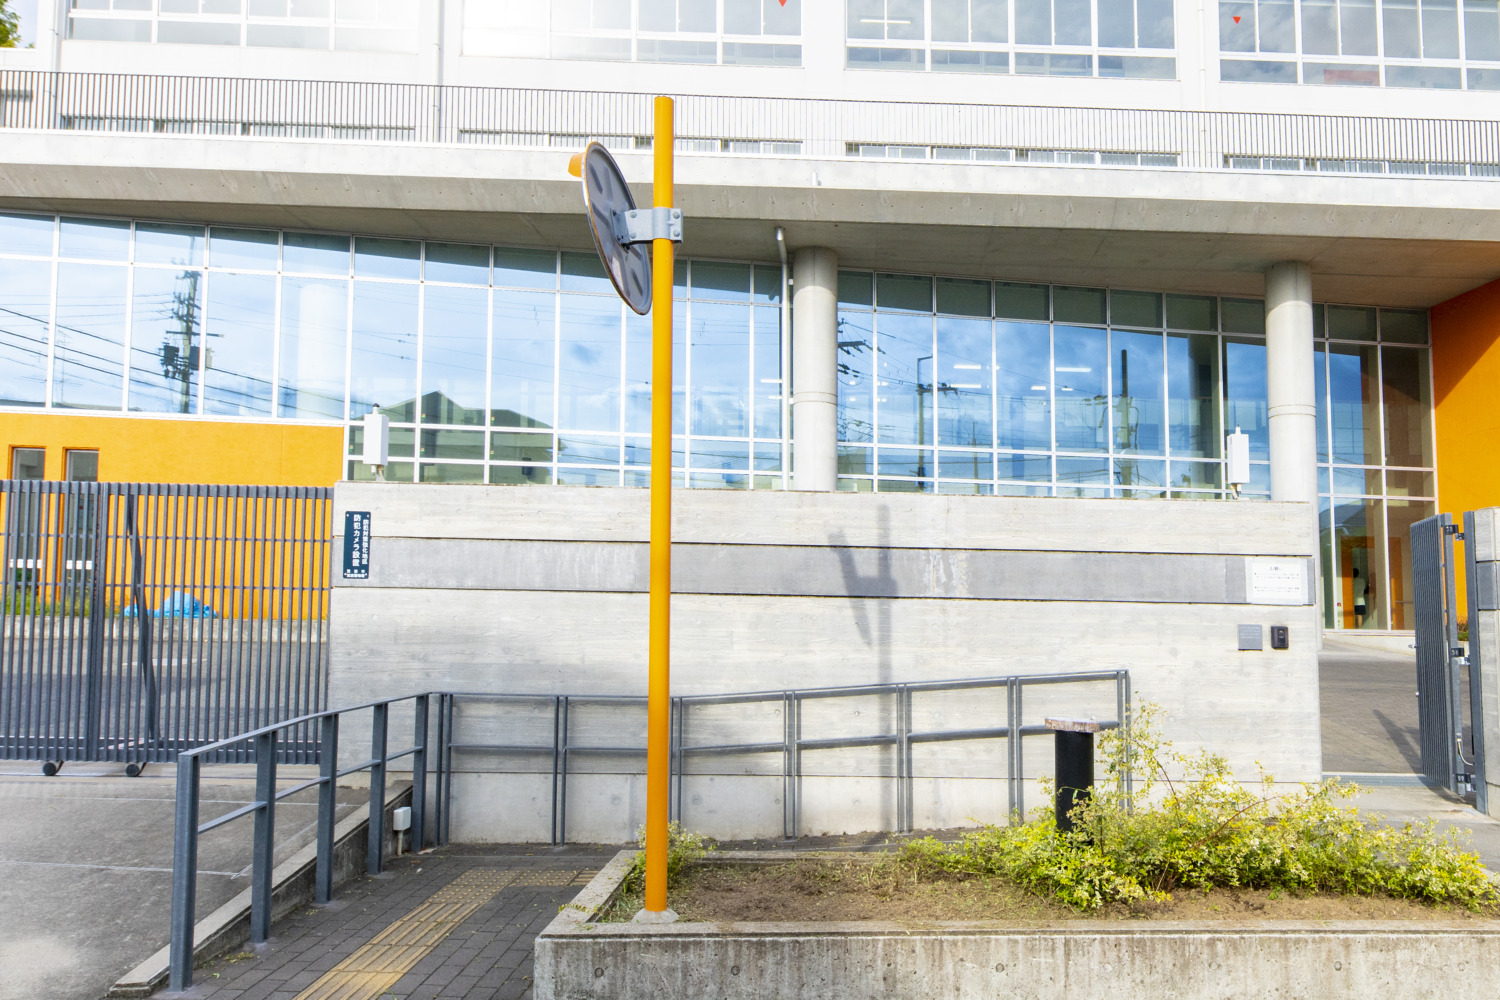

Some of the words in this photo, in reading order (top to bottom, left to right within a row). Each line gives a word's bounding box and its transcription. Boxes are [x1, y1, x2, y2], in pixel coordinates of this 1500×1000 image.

[352, 514, 361, 566] 防犯カメラ設置
